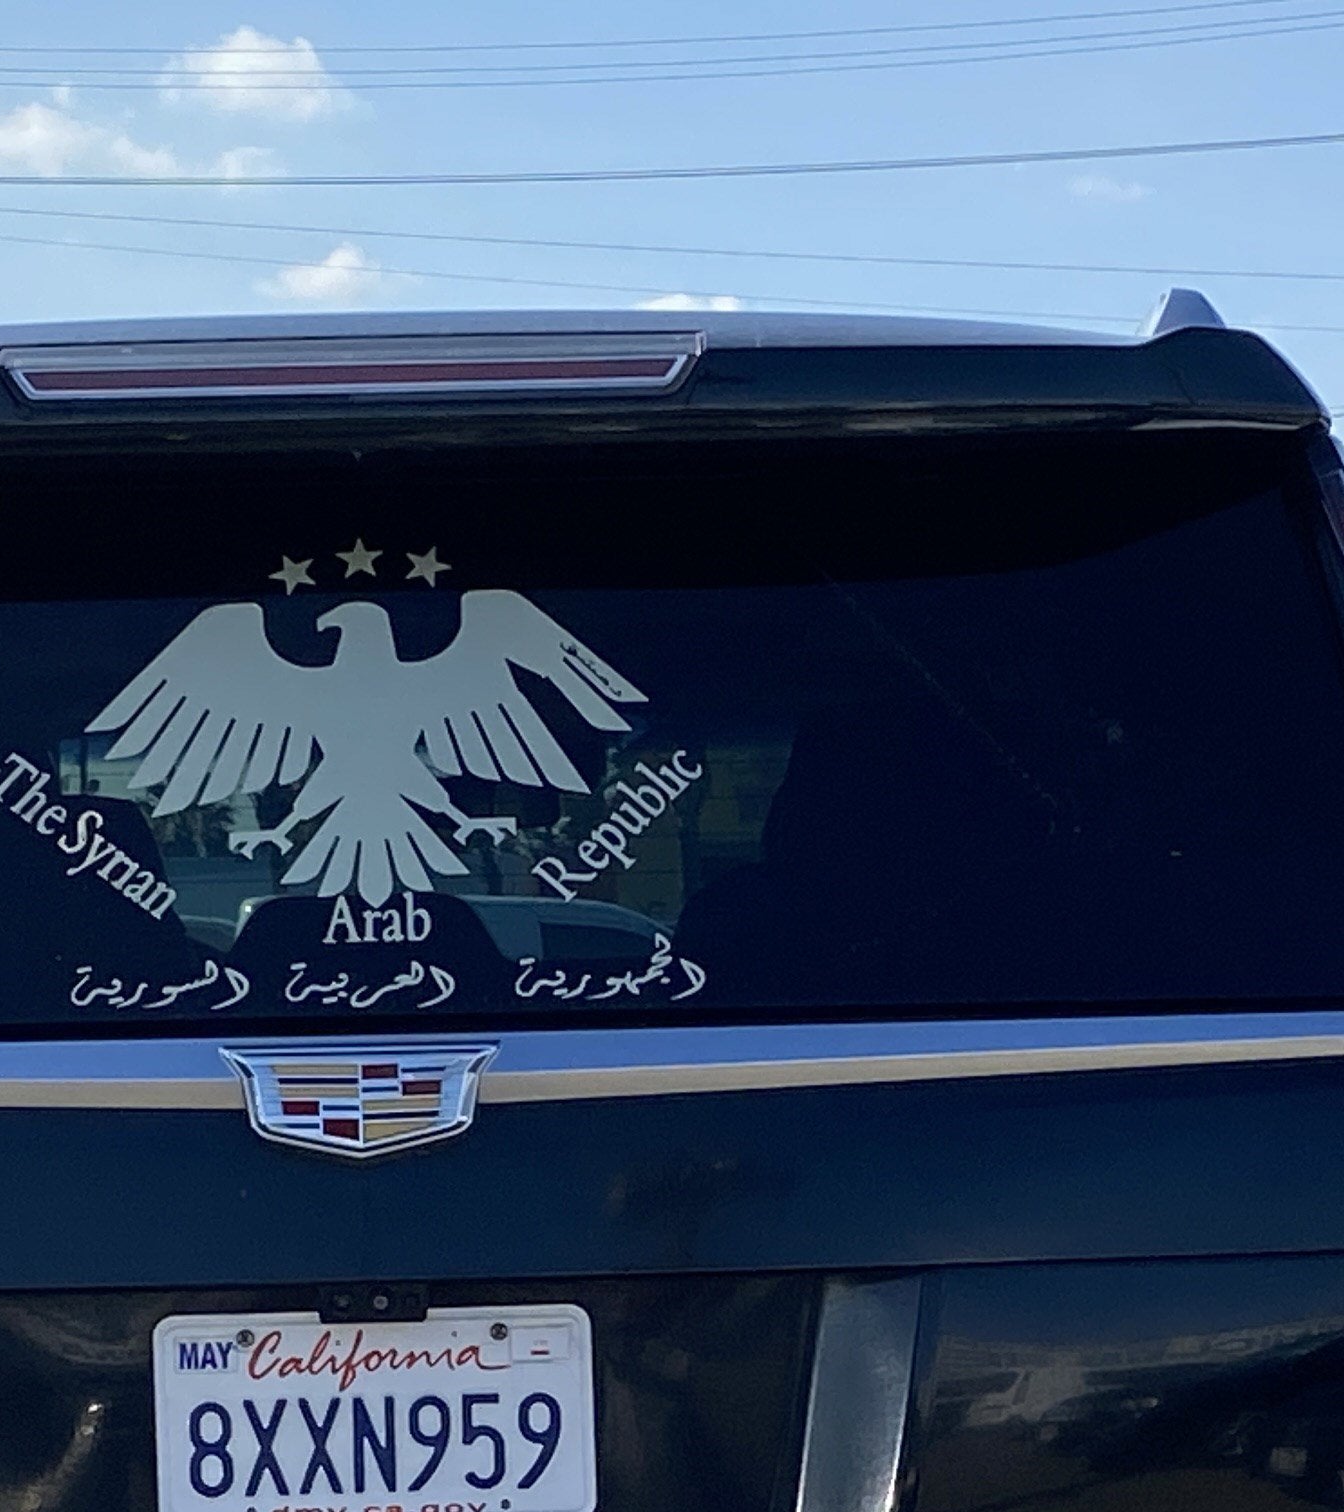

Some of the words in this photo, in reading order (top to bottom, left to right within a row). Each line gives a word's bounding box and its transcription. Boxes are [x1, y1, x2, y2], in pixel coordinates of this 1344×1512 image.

[530, 750, 703, 904] Republic
[57, 809, 178, 921] Syrian
[322, 892, 432, 944] Arab
[70, 959, 250, 1010] السورية
[284, 960, 456, 1008] العربية
[178, 1341, 234, 1371] MAY
[247, 1329, 513, 1392] California
[188, 1392, 563, 1499] 8XXN959
